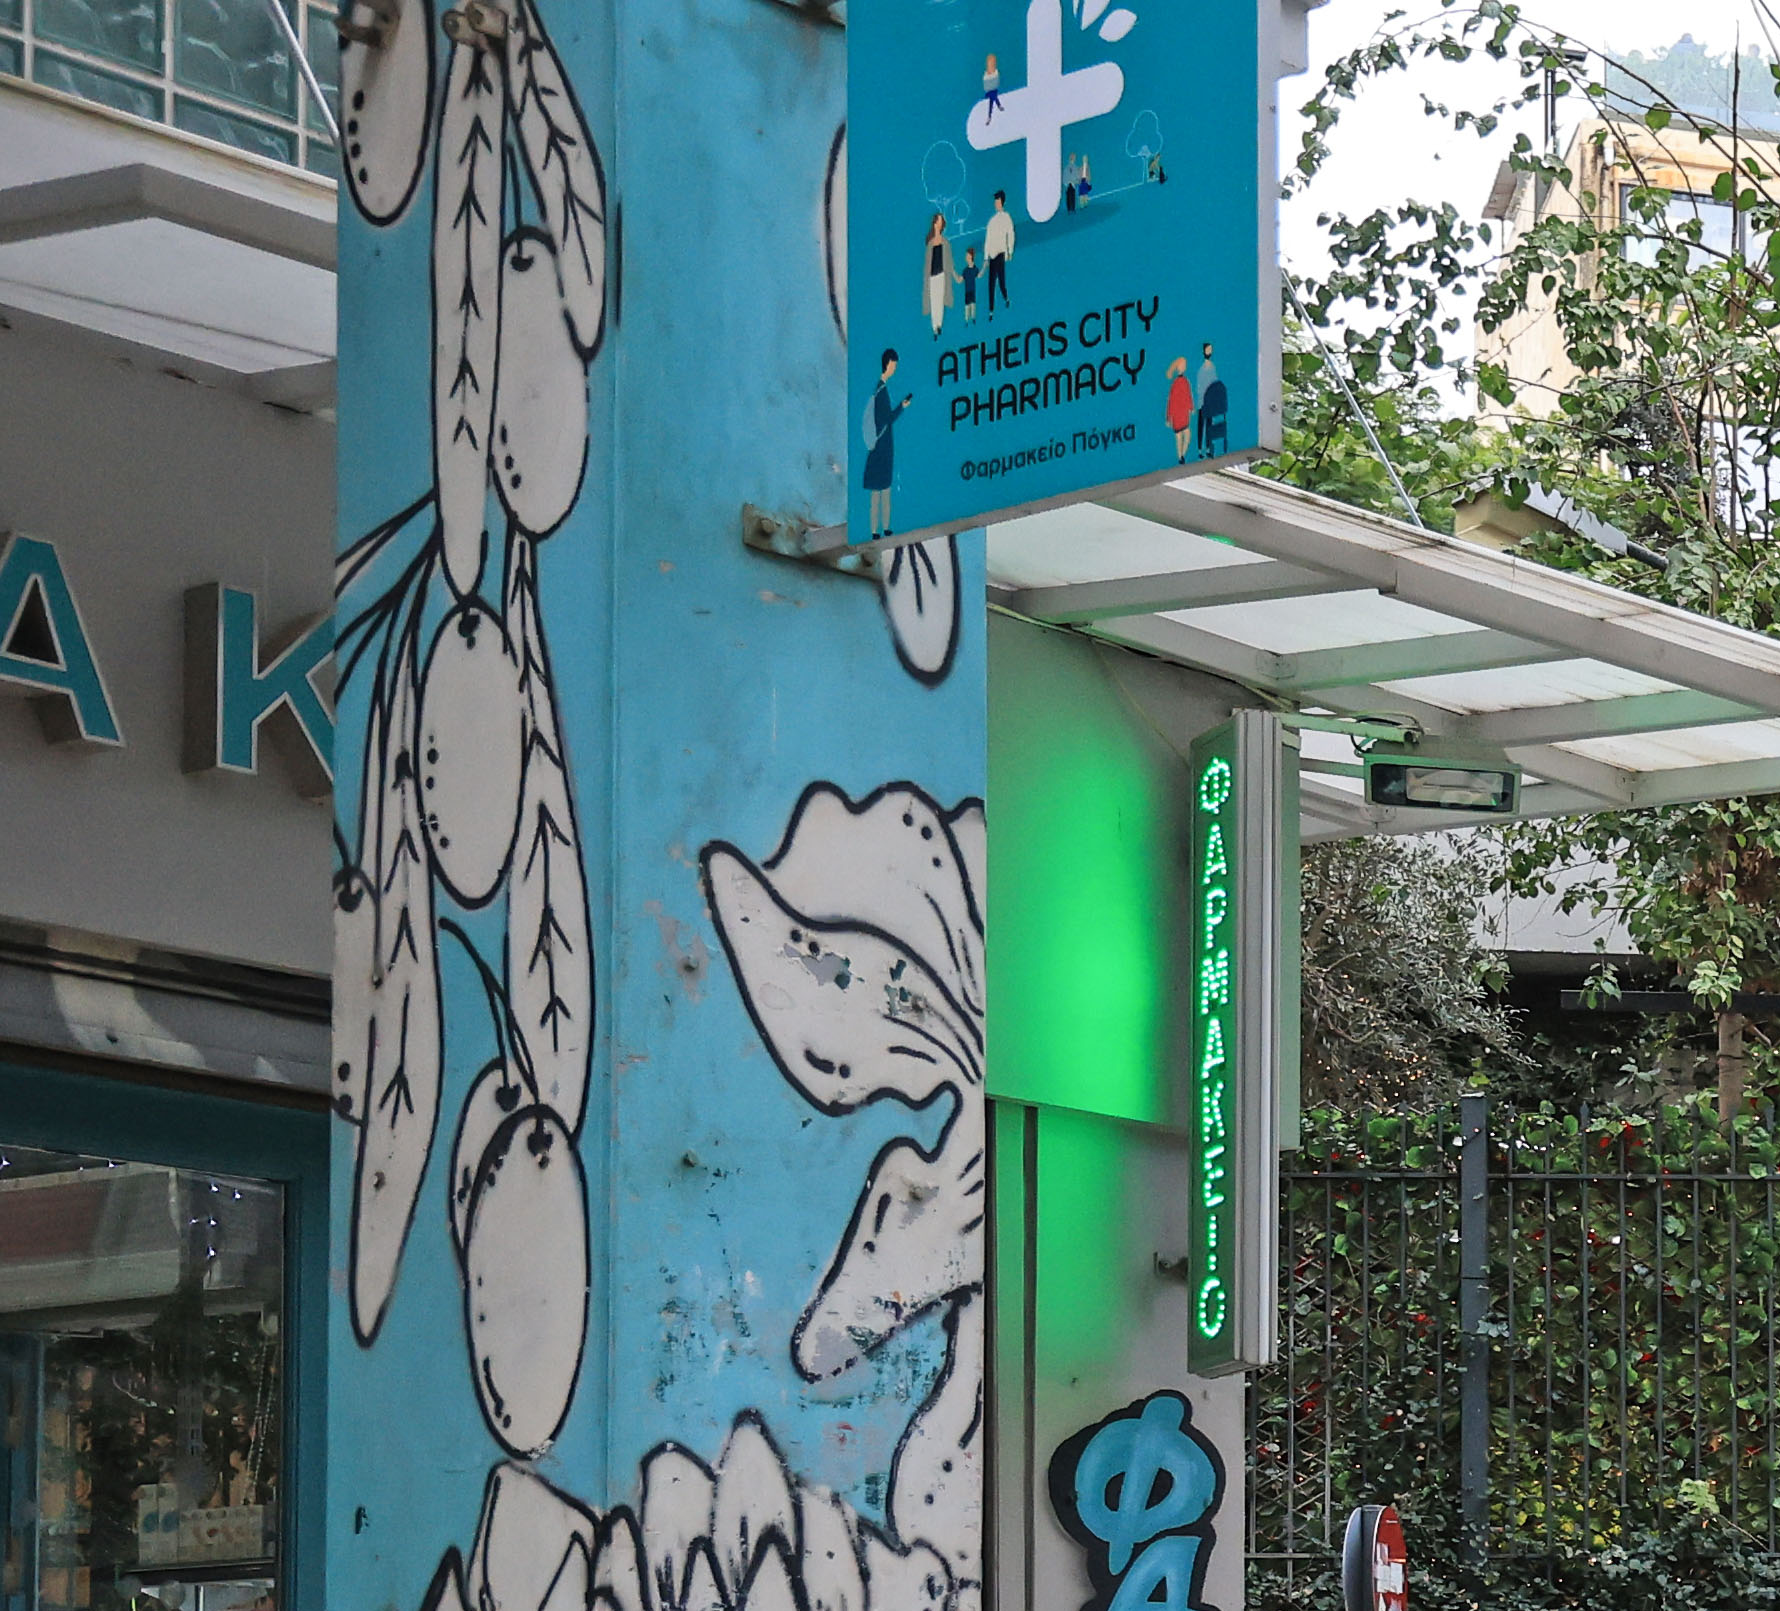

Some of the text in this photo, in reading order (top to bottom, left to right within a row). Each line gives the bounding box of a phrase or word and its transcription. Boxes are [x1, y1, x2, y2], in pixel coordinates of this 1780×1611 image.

[937, 295, 1160, 387] ATHENS CITY
[950, 348, 1147, 432] PHARMACY
[960, 422, 1137, 482] Φαρμακείο Πόγκα
[1199, 756, 1232, 1338] ΦΑΡΜΑΚΕΙΟ
